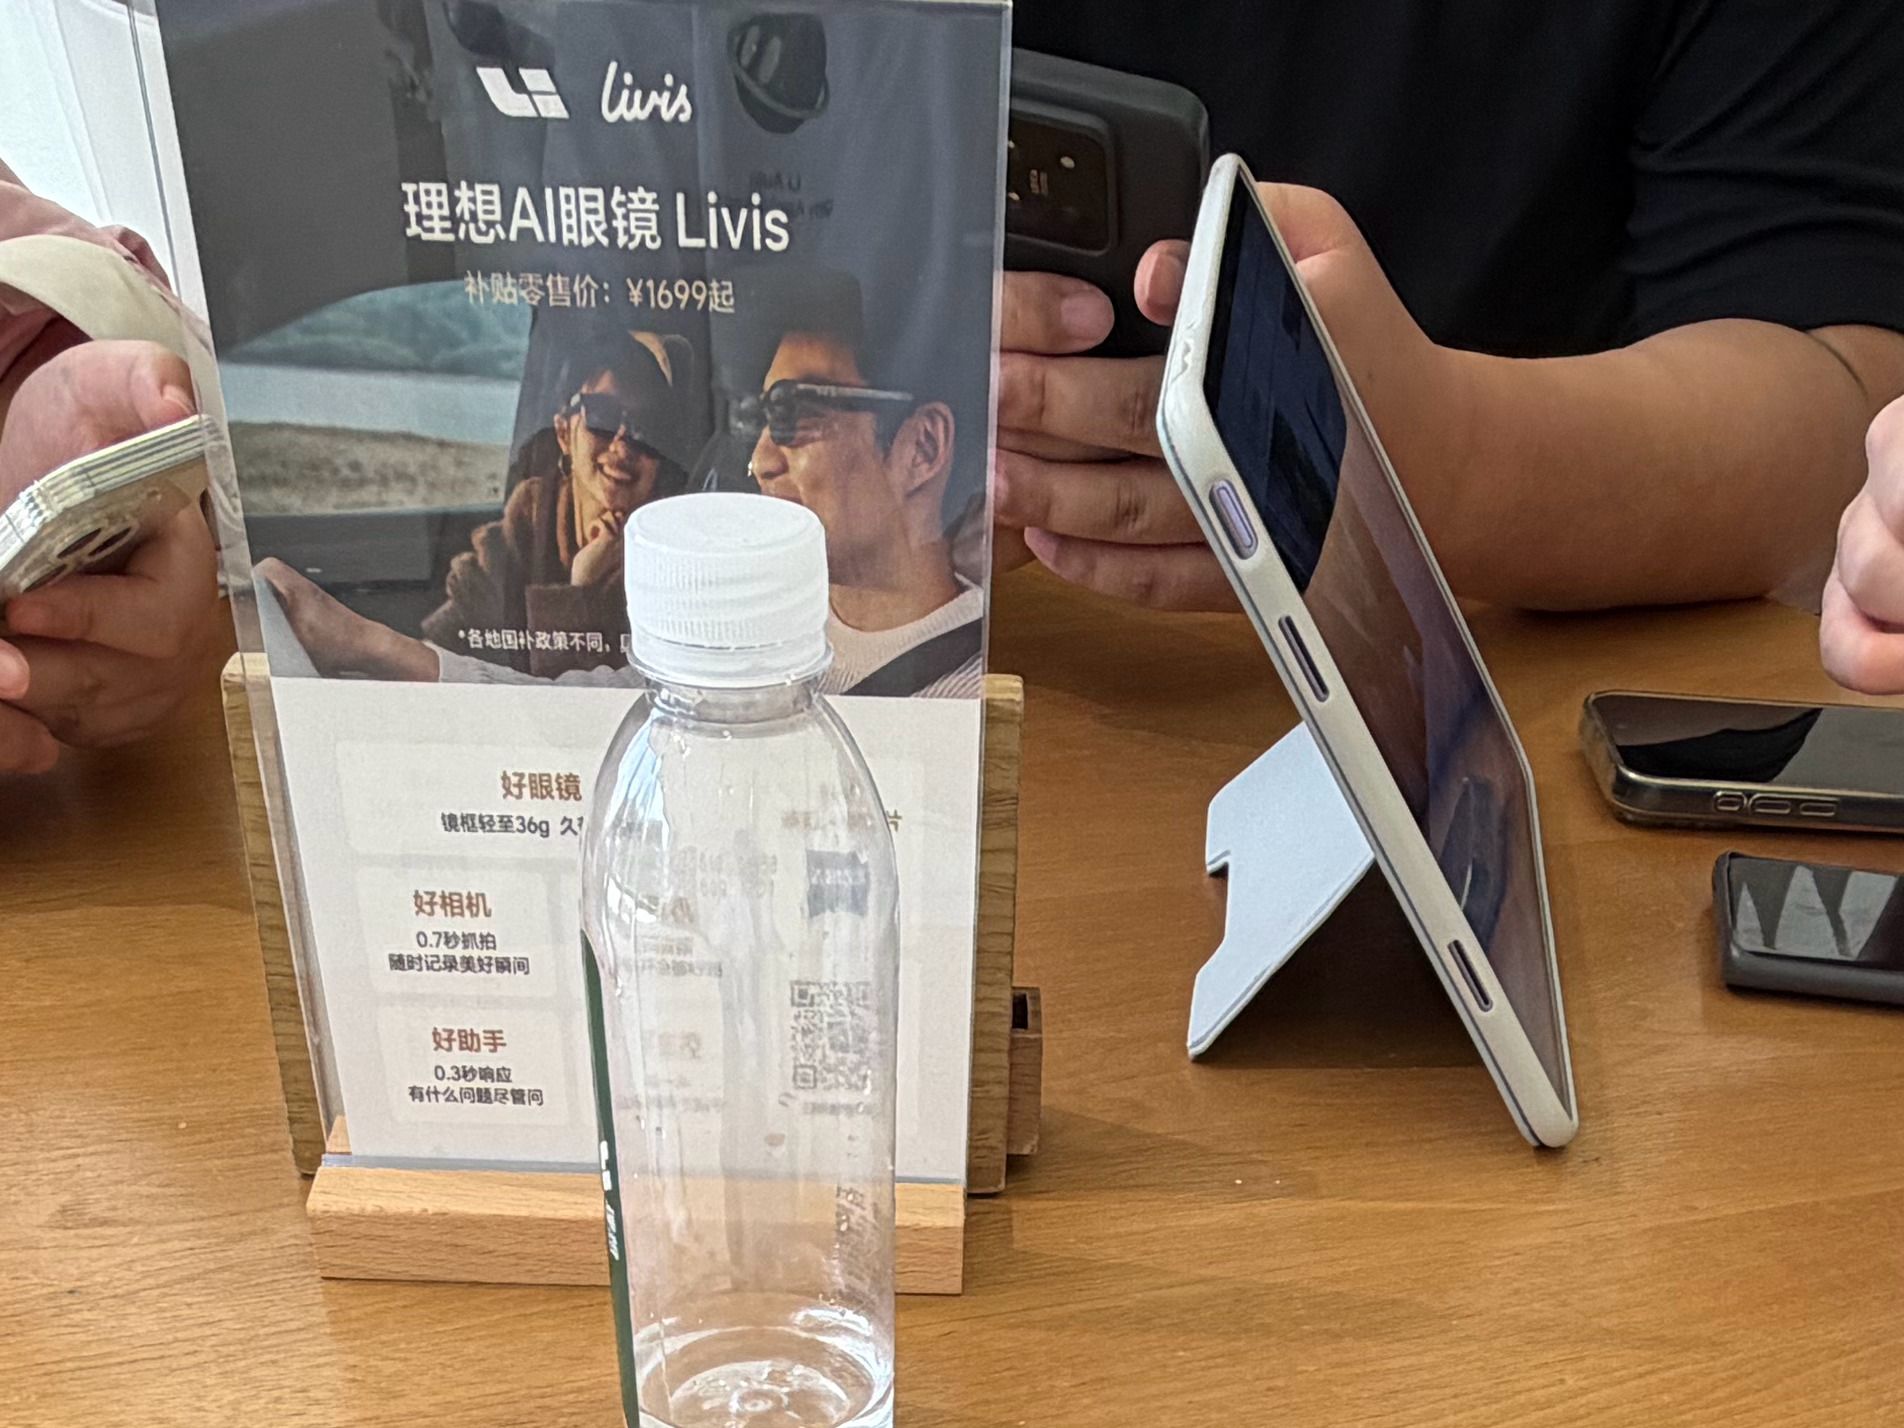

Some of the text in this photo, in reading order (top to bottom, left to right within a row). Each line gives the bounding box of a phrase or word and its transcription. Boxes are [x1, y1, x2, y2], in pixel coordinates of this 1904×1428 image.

[400, 180, 790, 252] 理想AI眼镜 Livis
[501, 769, 582, 802] 好眼镜
[441, 812, 550, 838] 镜框轻至36g
[412, 889, 492, 918] 好相机
[415, 930, 497, 951] 0.7秒抓拍
[388, 953, 530, 976] 随时记录美好瞬间
[431, 1026, 507, 1053] 好助手
[433, 1064, 513, 1083] 0.3秒响应
[408, 1085, 544, 1107] 有什么问题尽管问
